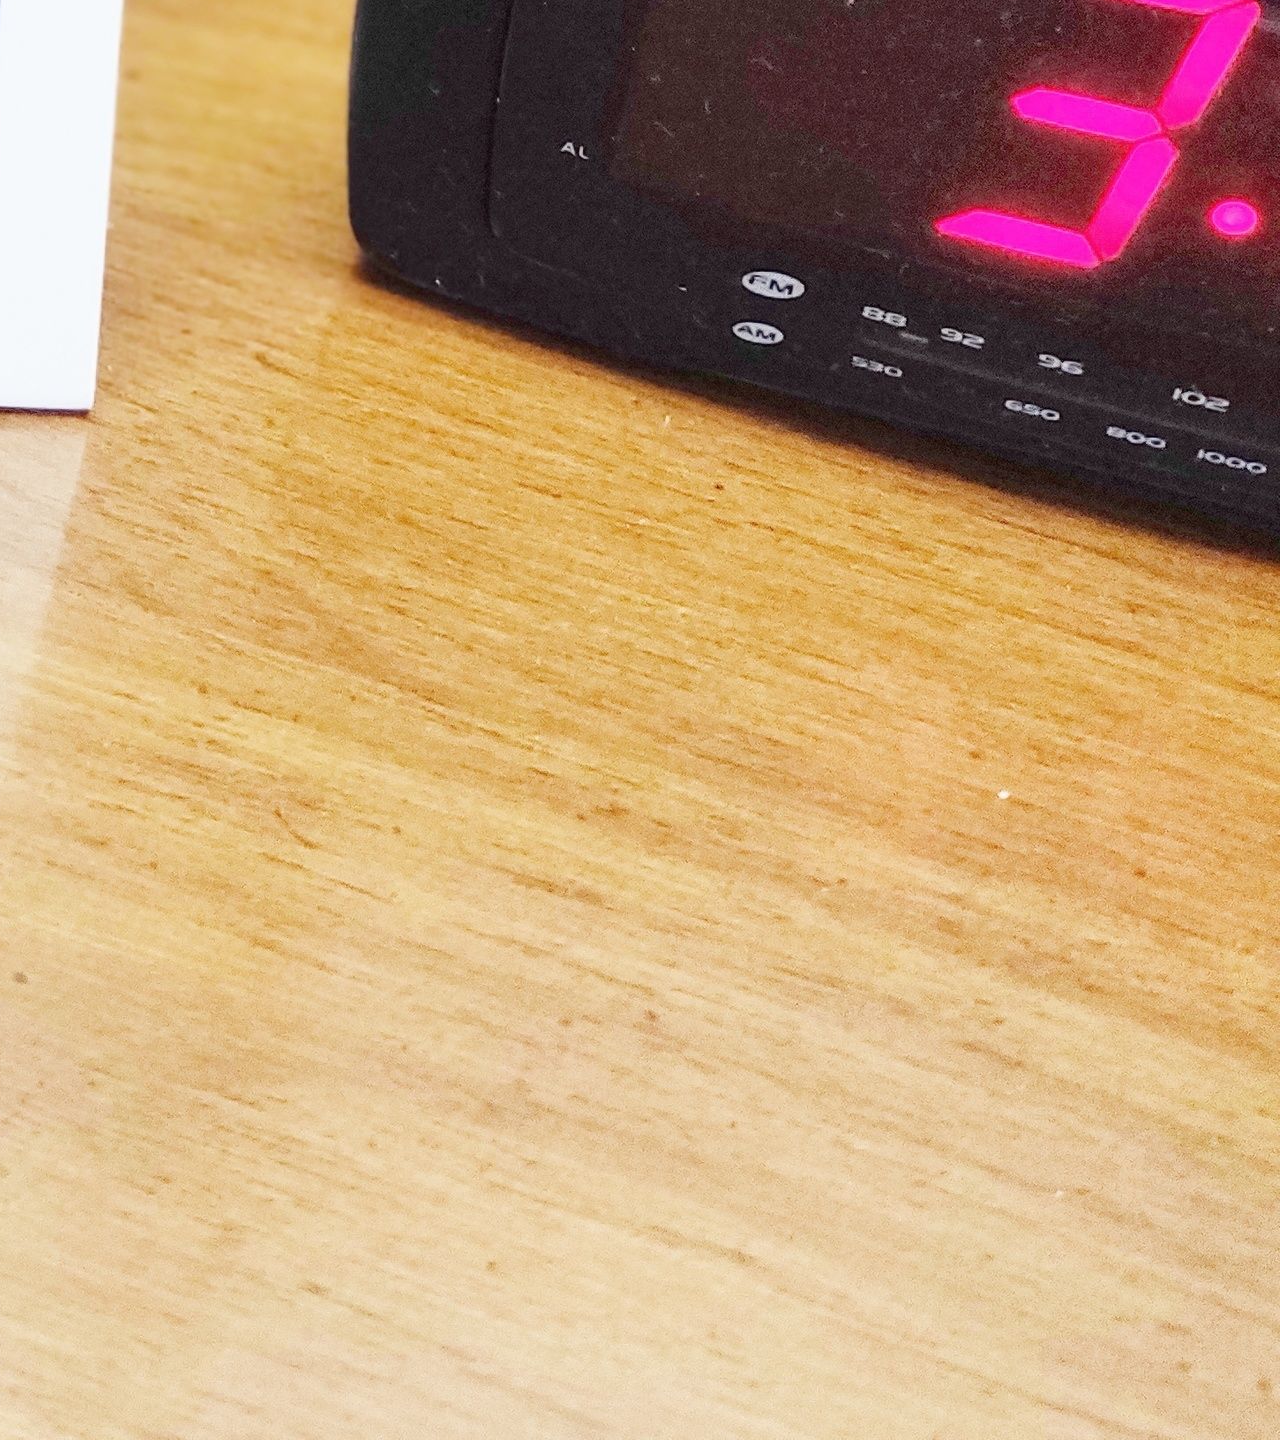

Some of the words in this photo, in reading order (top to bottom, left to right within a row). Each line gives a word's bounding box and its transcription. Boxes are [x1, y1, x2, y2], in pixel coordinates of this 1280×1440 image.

[560, 141, 589, 160] AL
[737, 324, 779, 343] AM
[1197, 449, 1267, 474] 1000
[746, 274, 797, 297] FM
[861, 306, 907, 327] 88
[940, 327, 985, 349] 92
[1038, 354, 1083, 375] 96
[1172, 387, 1230, 412] 102
